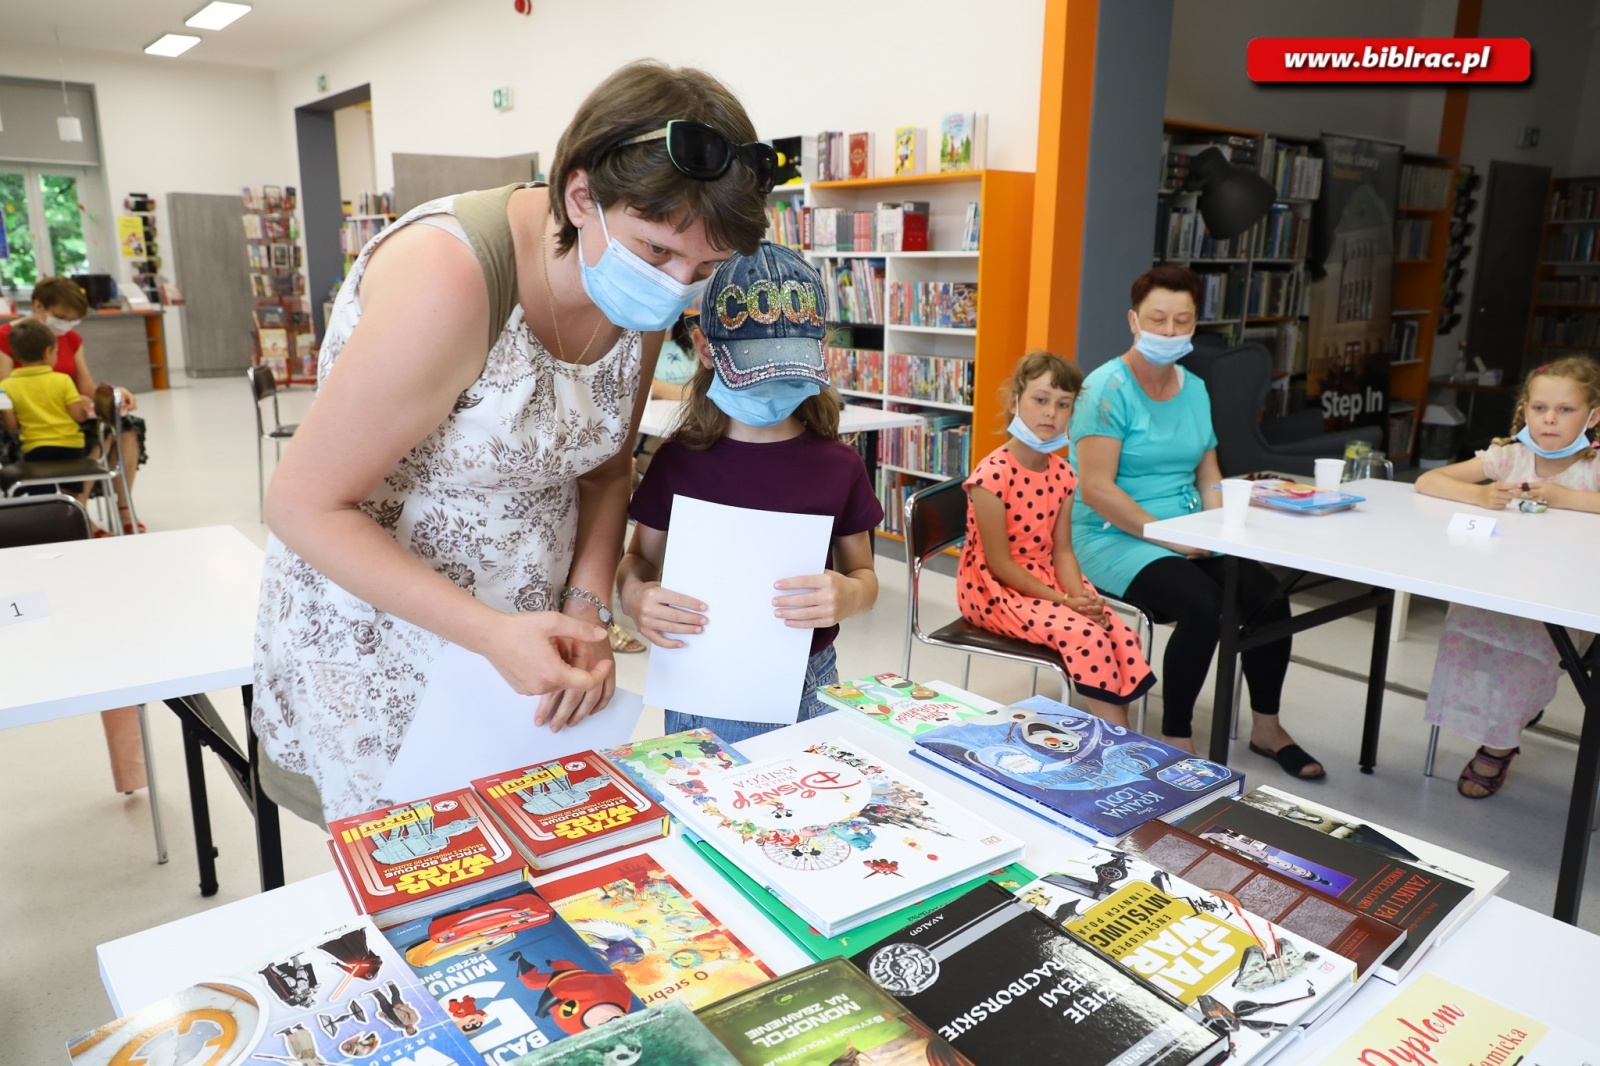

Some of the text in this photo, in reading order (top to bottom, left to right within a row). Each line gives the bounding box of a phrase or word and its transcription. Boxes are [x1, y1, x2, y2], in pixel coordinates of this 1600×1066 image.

[716, 279, 824, 330] COOL
[1321, 388, 1384, 422] Step In
[1466, 519, 1476, 531] 5
[10, 602, 24, 617] 1
[507, 771, 549, 790] AT-AT
[733, 766, 798, 788] KSIĘGA
[1095, 787, 1139, 811] LODU
[1101, 791, 1164, 819] KRAINA
[363, 813, 413, 833] AT-AT
[540, 810, 587, 826] BOJOWE
[554, 815, 632, 839] STAR
[555, 805, 638, 830] WARS
[384, 846, 487, 878] STACJE BOJOWE
[399, 853, 495, 884] WARS
[395, 866, 485, 894] STAR
[1391, 874, 1431, 904] ZAMKI
[1105, 892, 1143, 918] INNYCH
[397, 924, 422, 936] EGMONT
[1089, 893, 1172, 948] MYŚLIWC
[446, 953, 488, 974] PRZED
[694, 971, 709, 981] O
[938, 957, 1065, 1042] RACIBORSKIE
[1038, 968, 1096, 1008] ZIEMI
[1063, 977, 1129, 1024] DZIEJE
[744, 993, 849, 1039] NA ZBAWIENIE
[752, 1001, 862, 1048] MONOPOL
[834, 1015, 886, 1040] SZYMON
[1470, 1028, 1528, 1066] amicka
